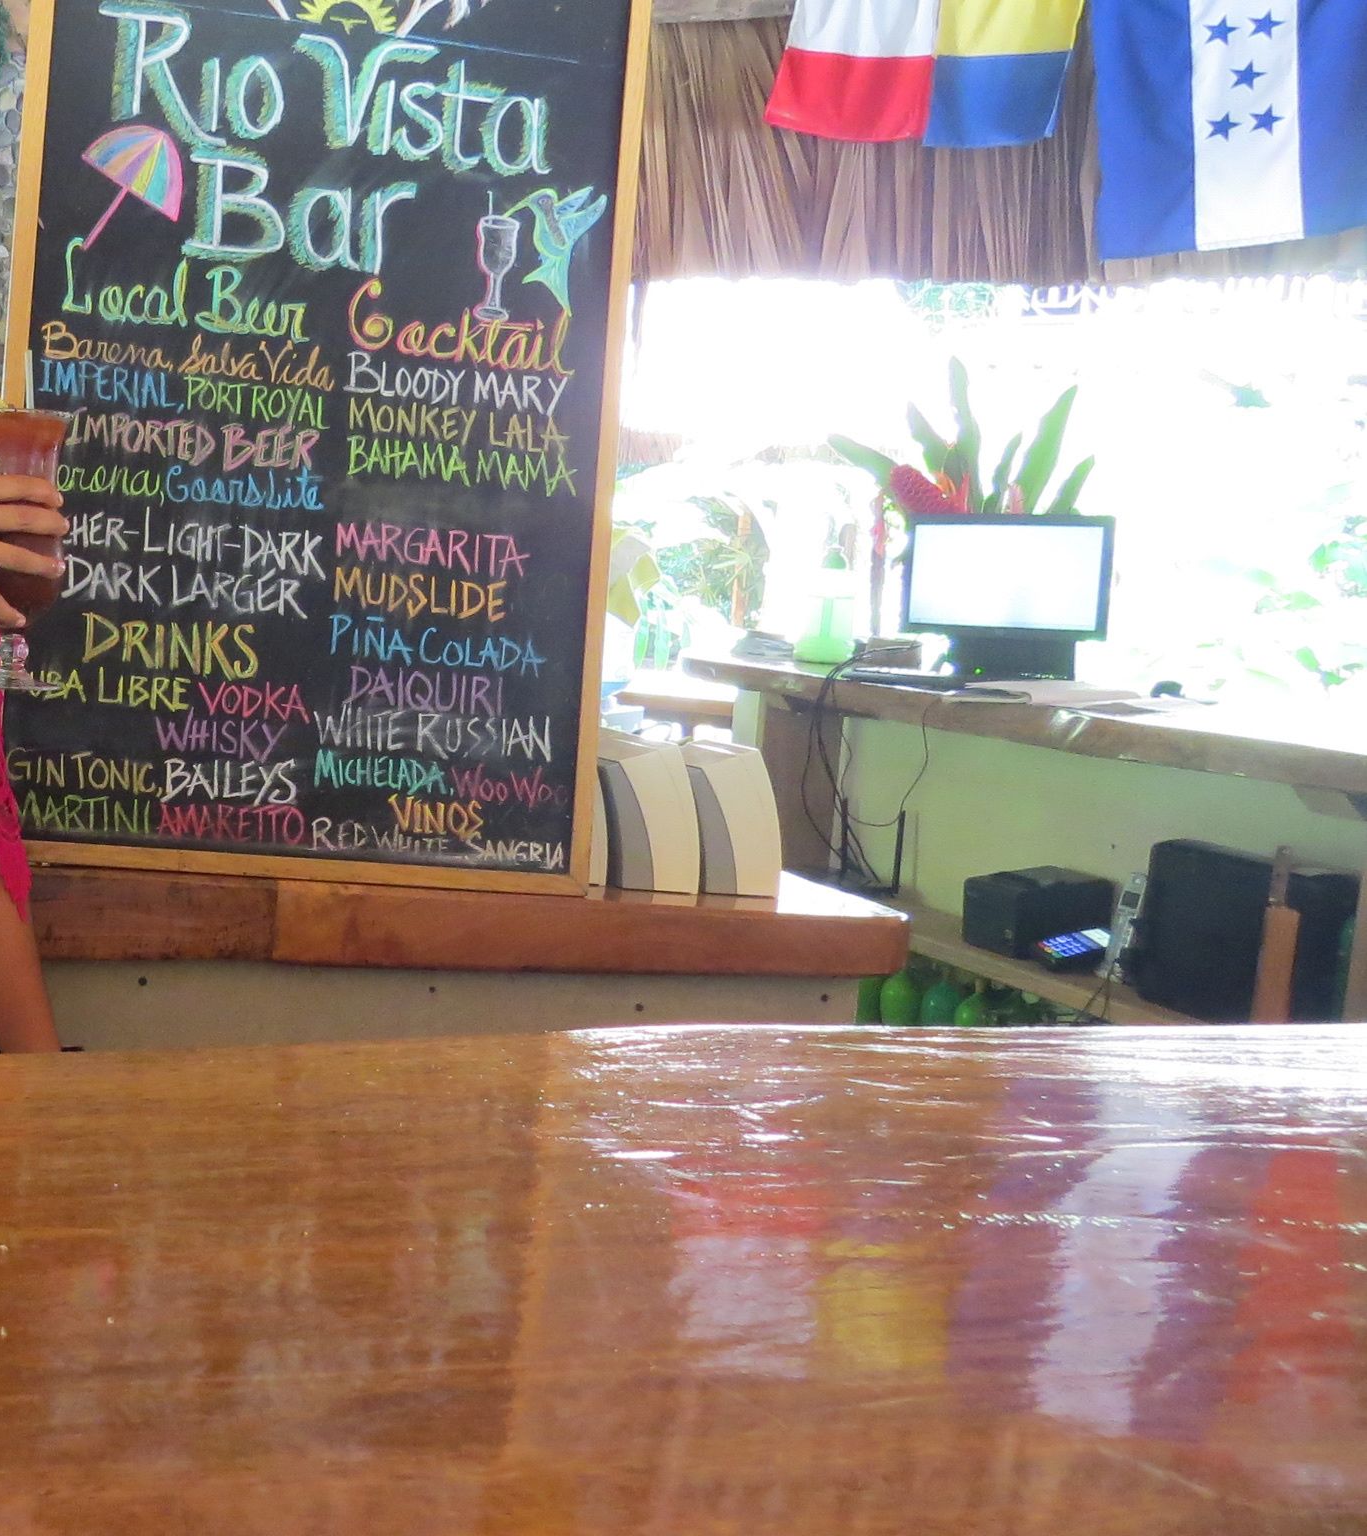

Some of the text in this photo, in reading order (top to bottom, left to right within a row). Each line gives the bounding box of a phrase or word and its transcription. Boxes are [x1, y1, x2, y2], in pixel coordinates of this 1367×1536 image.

[98, 1, 551, 176] Rio Vista
[181, 144, 416, 275] Bar
[62, 237, 311, 342] Local Beer
[348, 278, 575, 376] Cocktail
[39, 359, 331, 431] IMPERIAL, PORT ROYAL
[259, 339, 335, 391] Vida
[343, 350, 568, 417] BLOODY MARY
[65, 407, 321, 473] IMPORTED BEER
[348, 397, 570, 454] MONKEY LALA
[56, 464, 165, 506] orona,
[346, 435, 578, 498] BAHAMA MAMA
[336, 521, 530, 578] MARGARITA
[61, 554, 308, 619] DARK LARGER
[334, 566, 507, 622] MUDSLIDE
[82, 612, 259, 681] DRINKS
[329, 614, 547, 678] PIÑA COLADA
[30, 666, 310, 724] UBA LIBRE VODKA
[342, 665, 503, 717] DAIQUIRI
[155, 707, 288, 763] WHISKY
[314, 701, 552, 763] WHITE RUSSIAN
[7, 747, 65, 788] GIN
[160, 757, 298, 807] BAILEYS
[20, 790, 305, 846] MARTINI AMARETTO
[308, 816, 565, 869] RED WHITE SANGRIA
[388, 793, 483, 840] VINOS
